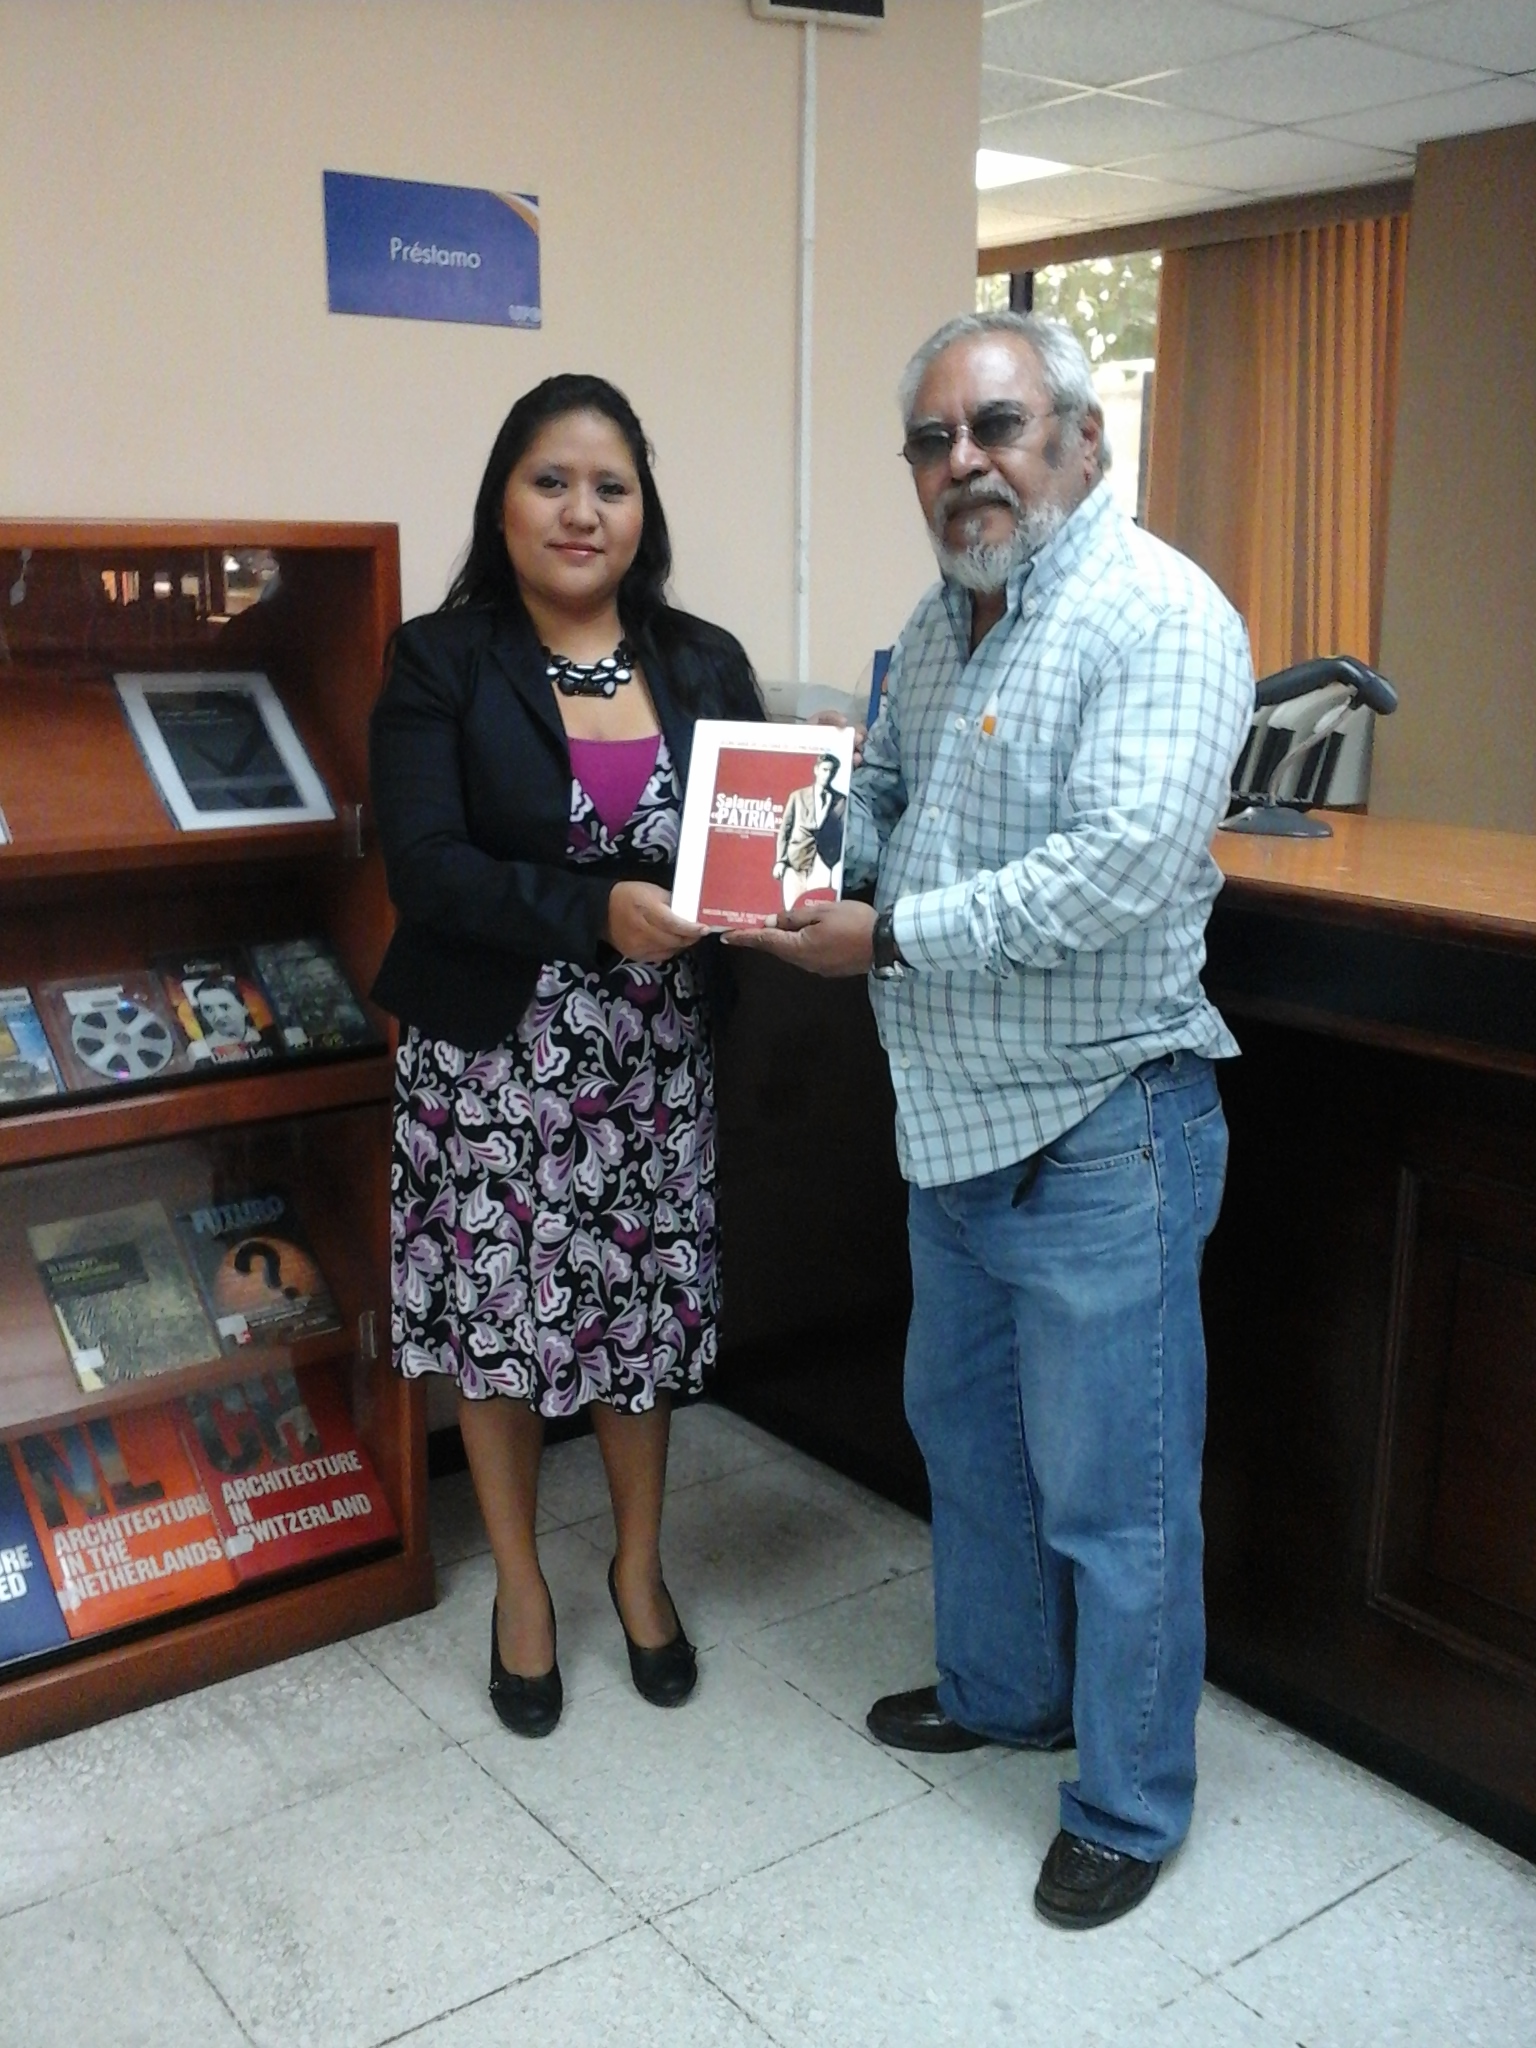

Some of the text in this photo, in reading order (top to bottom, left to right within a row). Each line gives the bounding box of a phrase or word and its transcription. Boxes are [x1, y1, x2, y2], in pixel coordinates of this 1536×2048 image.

[390, 237, 481, 269] Préstamo
[715, 792, 773, 812] Salarrué
[18, 1416, 165, 1531] NL
[221, 1450, 362, 1504] ARCHITECTURE
[228, 1500, 253, 1527] IN
[60, 1538, 132, 1580] IN THE
